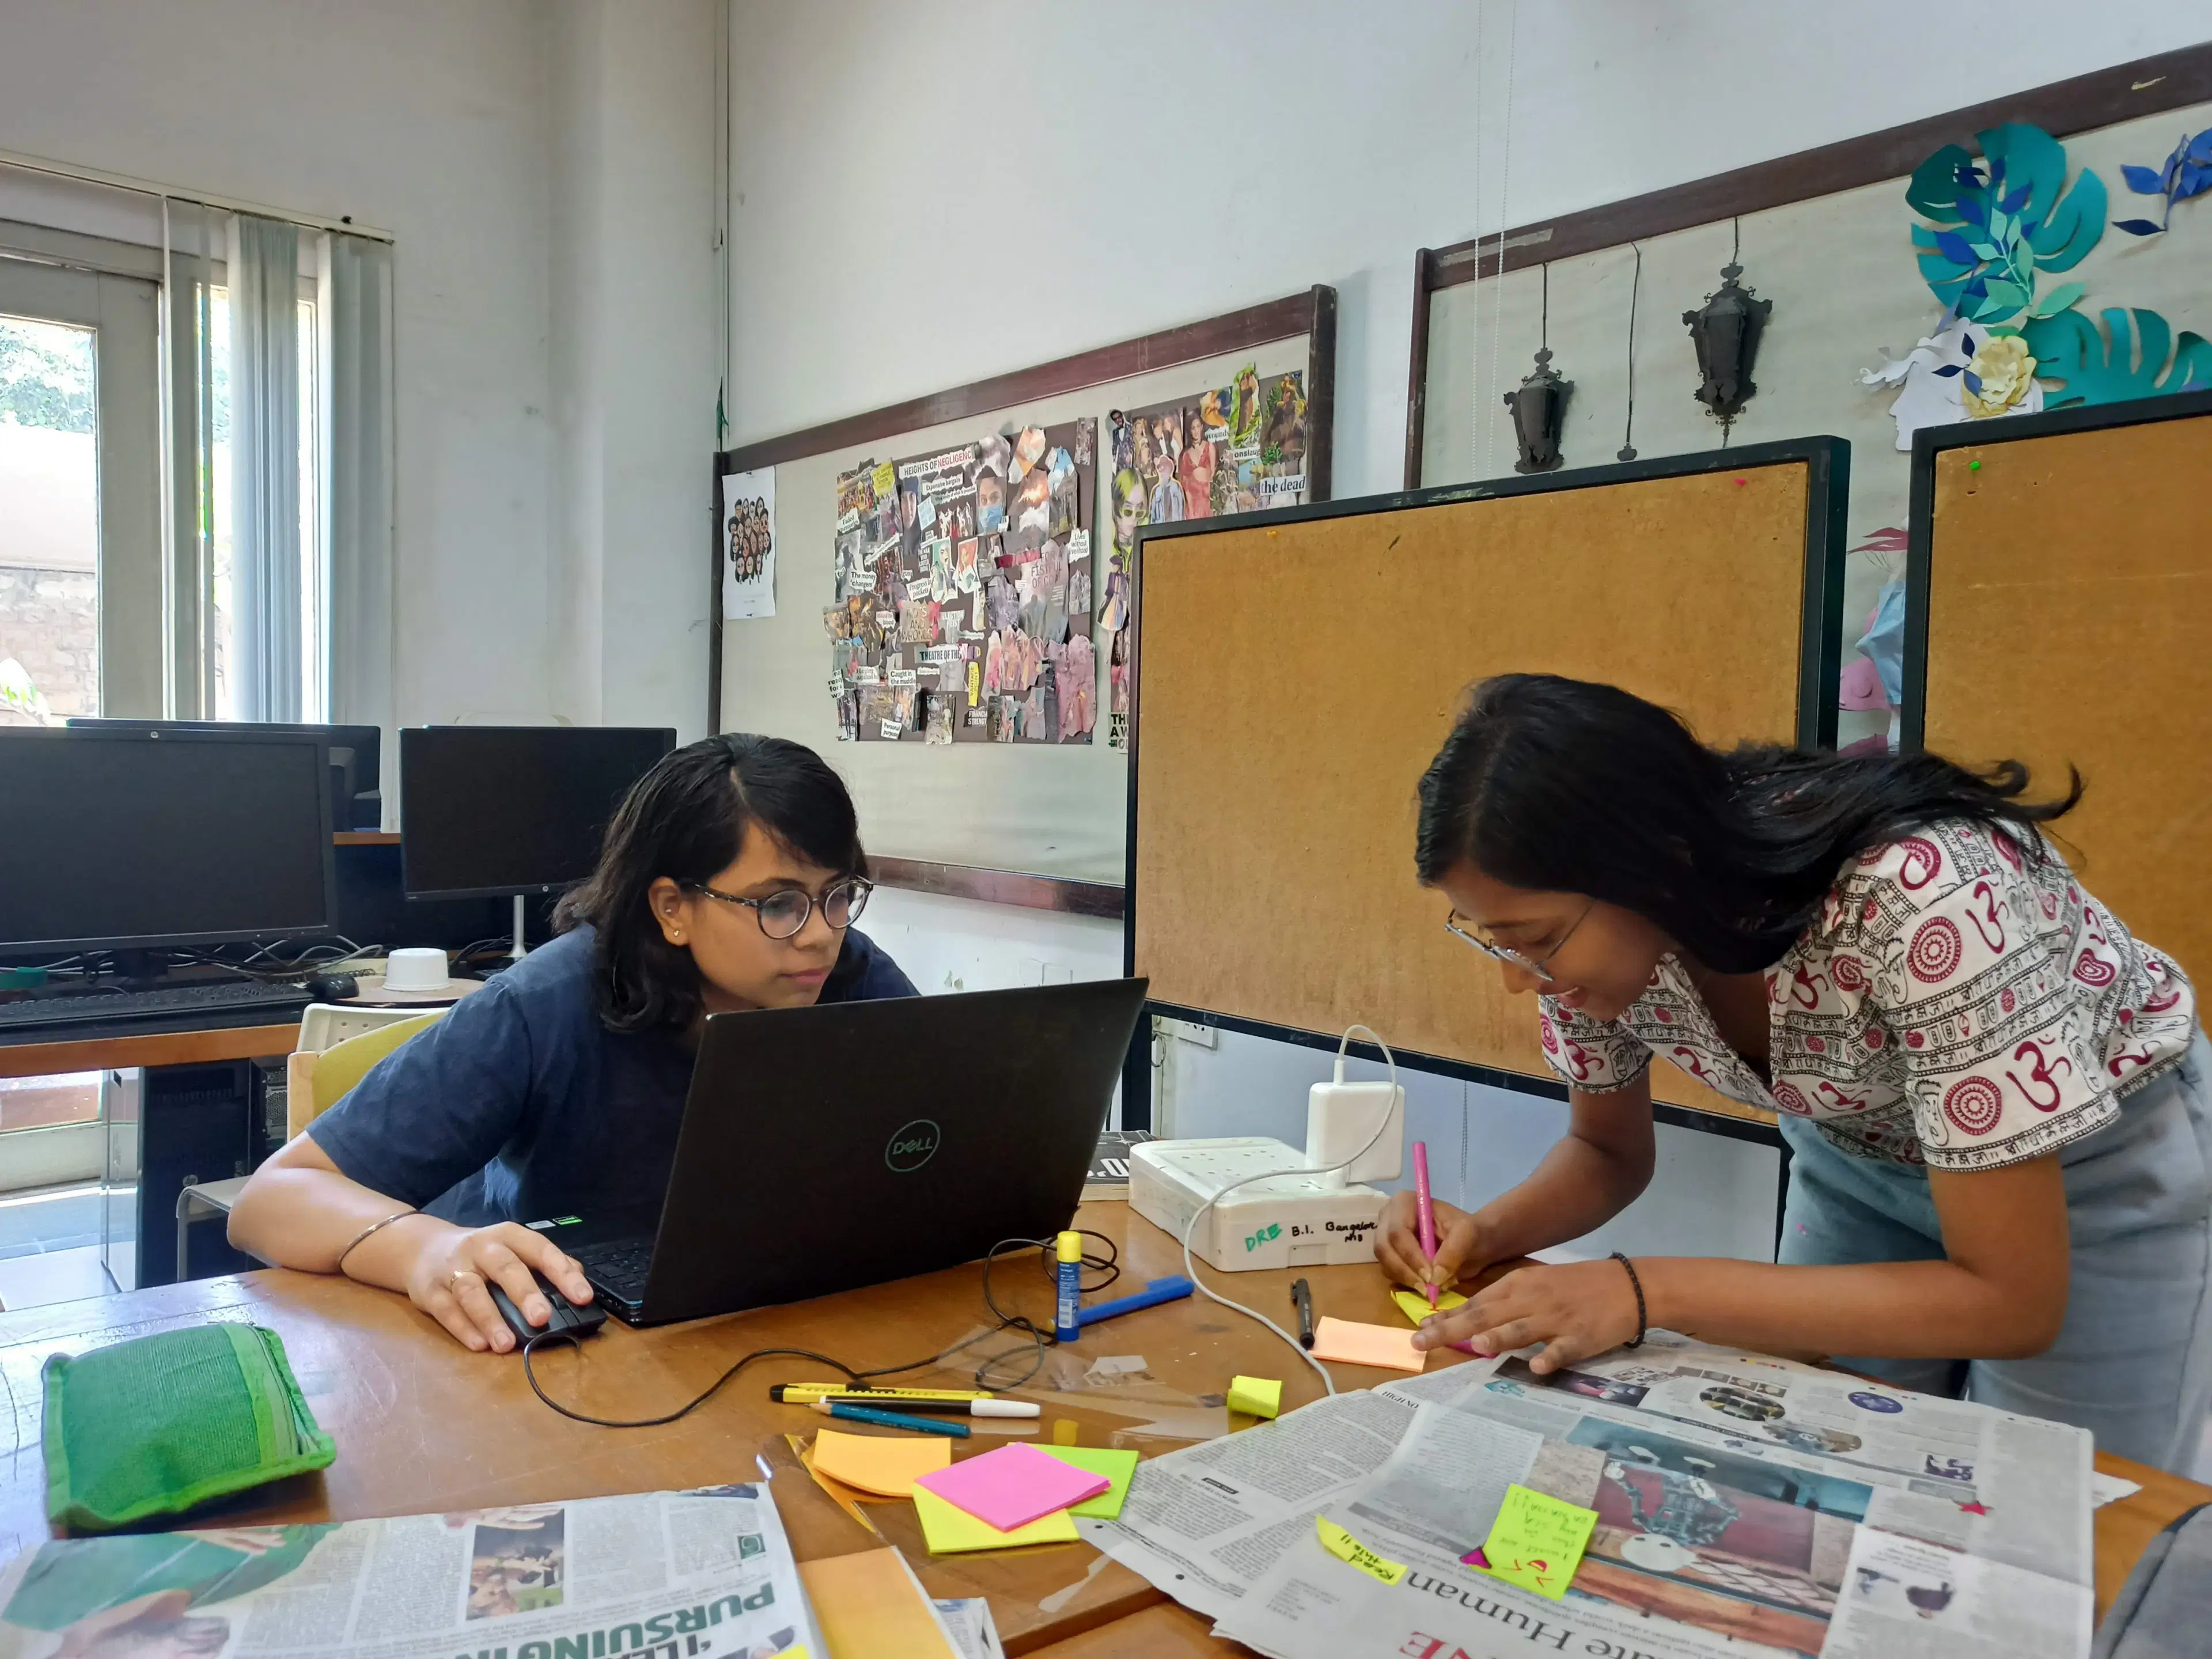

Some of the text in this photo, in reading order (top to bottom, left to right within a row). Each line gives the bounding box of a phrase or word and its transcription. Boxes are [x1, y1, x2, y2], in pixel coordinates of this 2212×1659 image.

[904, 463, 931, 476] HEIGHTS
[930, 461, 937, 469] OF
[1261, 476, 1305, 493] the dead
[1031, 562, 1062, 577] FISTFUL
[861, 573, 875, 582] money
[910, 618, 925, 629] AND
[920, 651, 944, 661] THEATRE
[944, 650, 950, 659] OF
[951, 649, 960, 659] THE
[891, 671, 906, 679] Caught
[884, 722, 900, 731] Personal
[1110, 726, 1119, 737] A
[892, 1137, 933, 1155] DELL
[1244, 1222, 1283, 1252] DRE
[1382, 1391, 1406, 1403] HIGH
[1349, 1554, 1395, 1580] Read
[1407, 1571, 1575, 1651] Human
[517, 1582, 775, 1659] PURSUING
